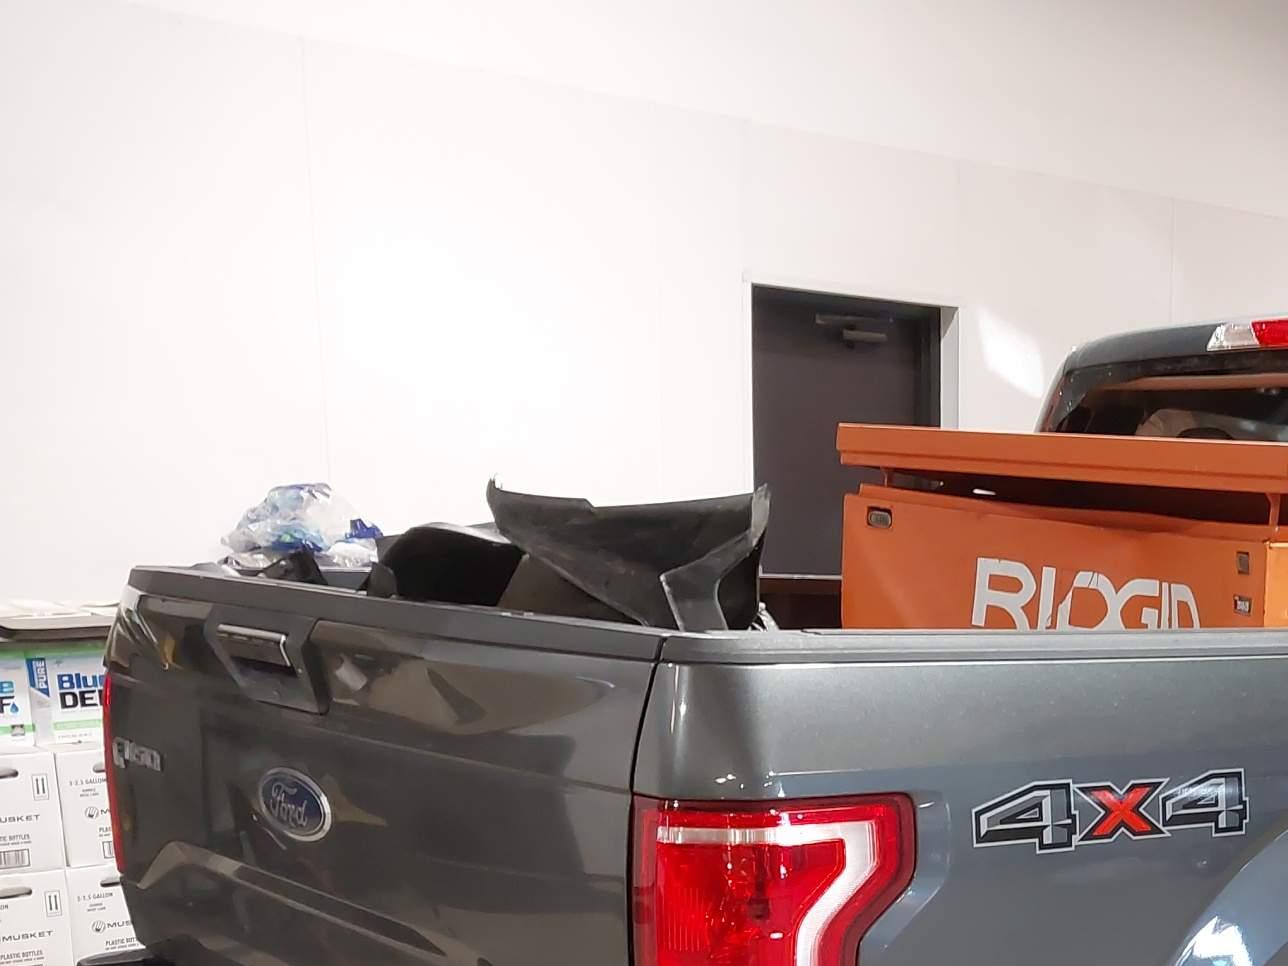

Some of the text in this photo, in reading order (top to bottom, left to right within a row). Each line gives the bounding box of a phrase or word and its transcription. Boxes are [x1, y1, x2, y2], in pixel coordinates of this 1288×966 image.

[36, 660, 48, 689] PURE
[269, 780, 309, 828] Ford
[0, 814, 40, 824] USKET
[107, 920, 131, 929] MUS
[2, 930, 54, 942] MUSKET
